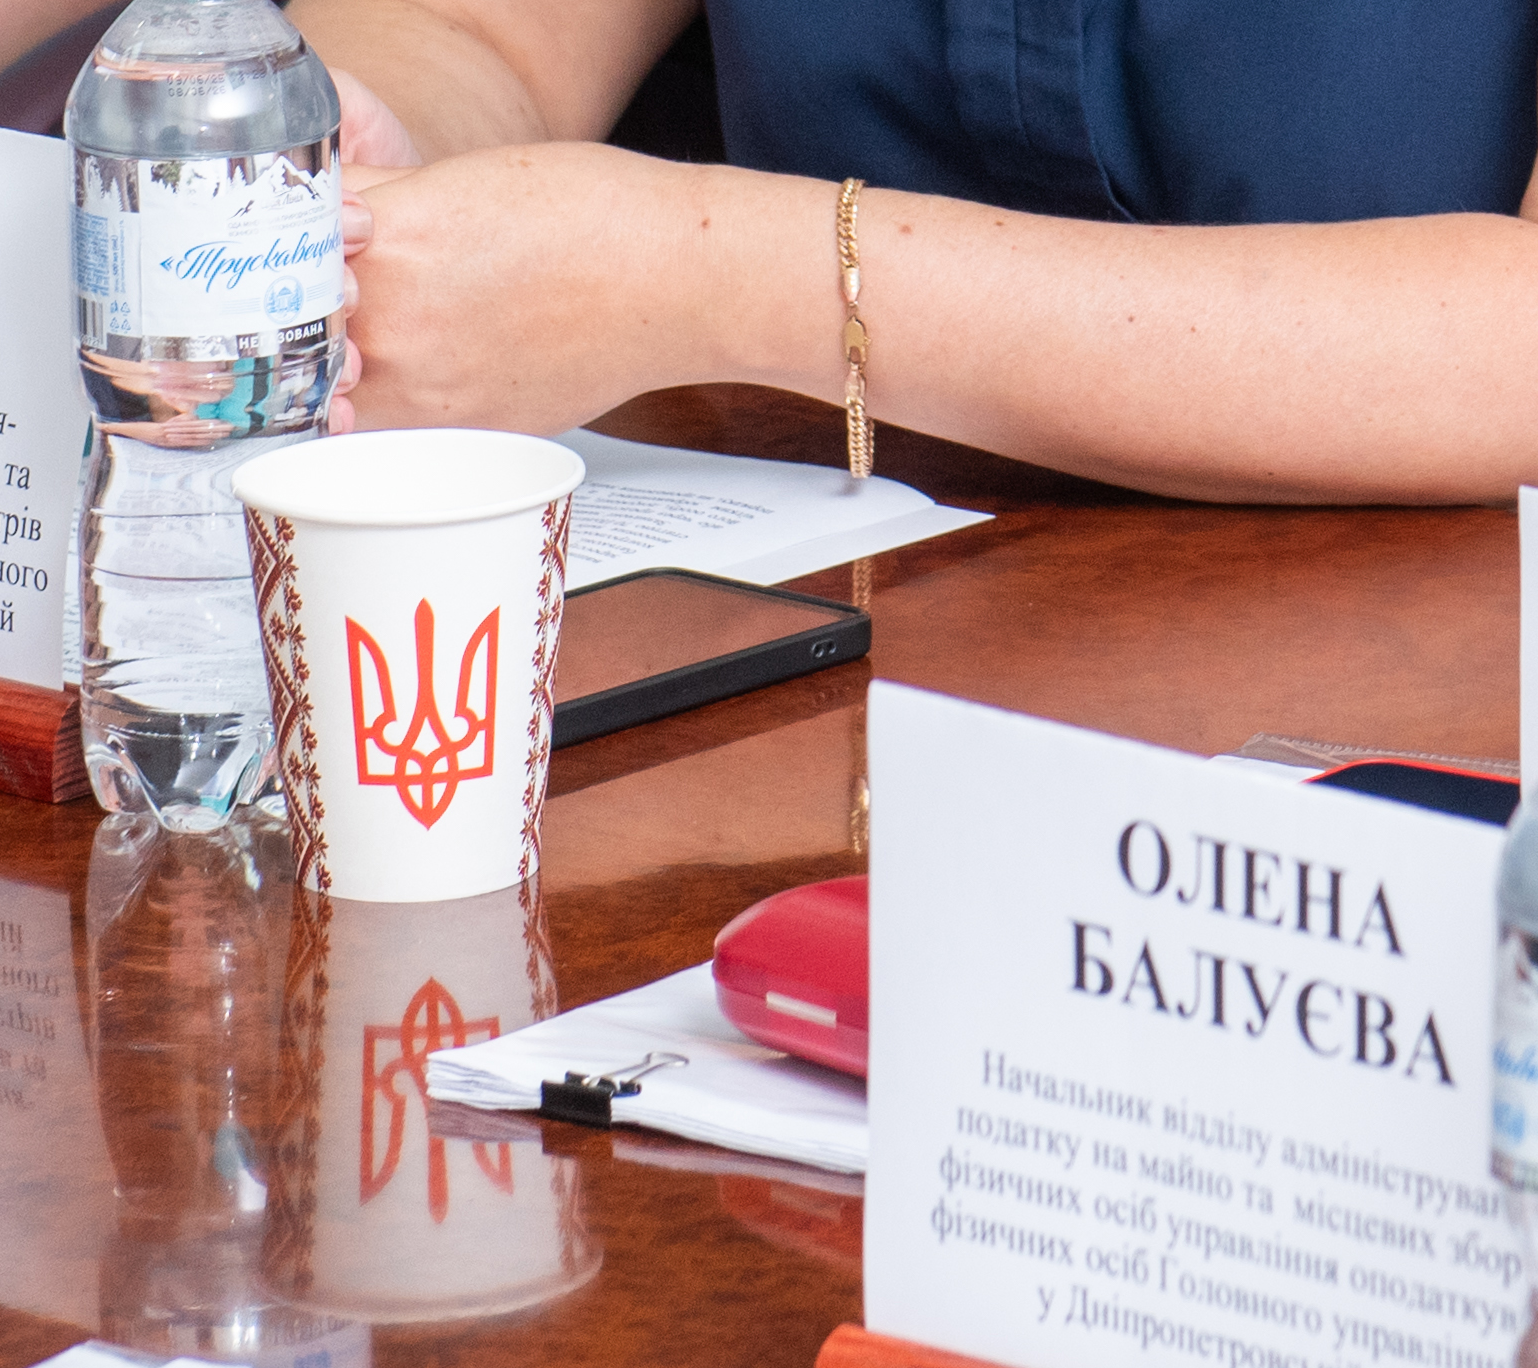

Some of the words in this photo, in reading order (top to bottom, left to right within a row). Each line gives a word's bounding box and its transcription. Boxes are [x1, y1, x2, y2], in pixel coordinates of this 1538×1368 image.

[238, 320, 325, 351] НЕЗОВАНА
[3, 462, 31, 491] та
[1115, 819, 1404, 958] ОЛЕНА
[1071, 919, 1455, 1088] БАЛУЄВА
[981, 1047, 1152, 1127] Начальник
[1161, 1098, 1272, 1168] відділу
[937, 1143, 1083, 1217] фізичних
[1091, 1191, 1158, 1249] осіб
[1165, 1211, 1339, 1288] управління
[956, 1105, 1084, 1171] податку
[1091, 1138, 1129, 1175] на
[1137, 1150, 1234, 1202] майно
[1241, 1180, 1275, 1216] та
[1292, 1189, 1444, 1260] місцевих
[929, 1195, 1074, 1267] фізичних
[1084, 1245, 1150, 1285] осіб
[1158, 1244, 1323, 1333] Головного
[1037, 1284, 1056, 1325] у
